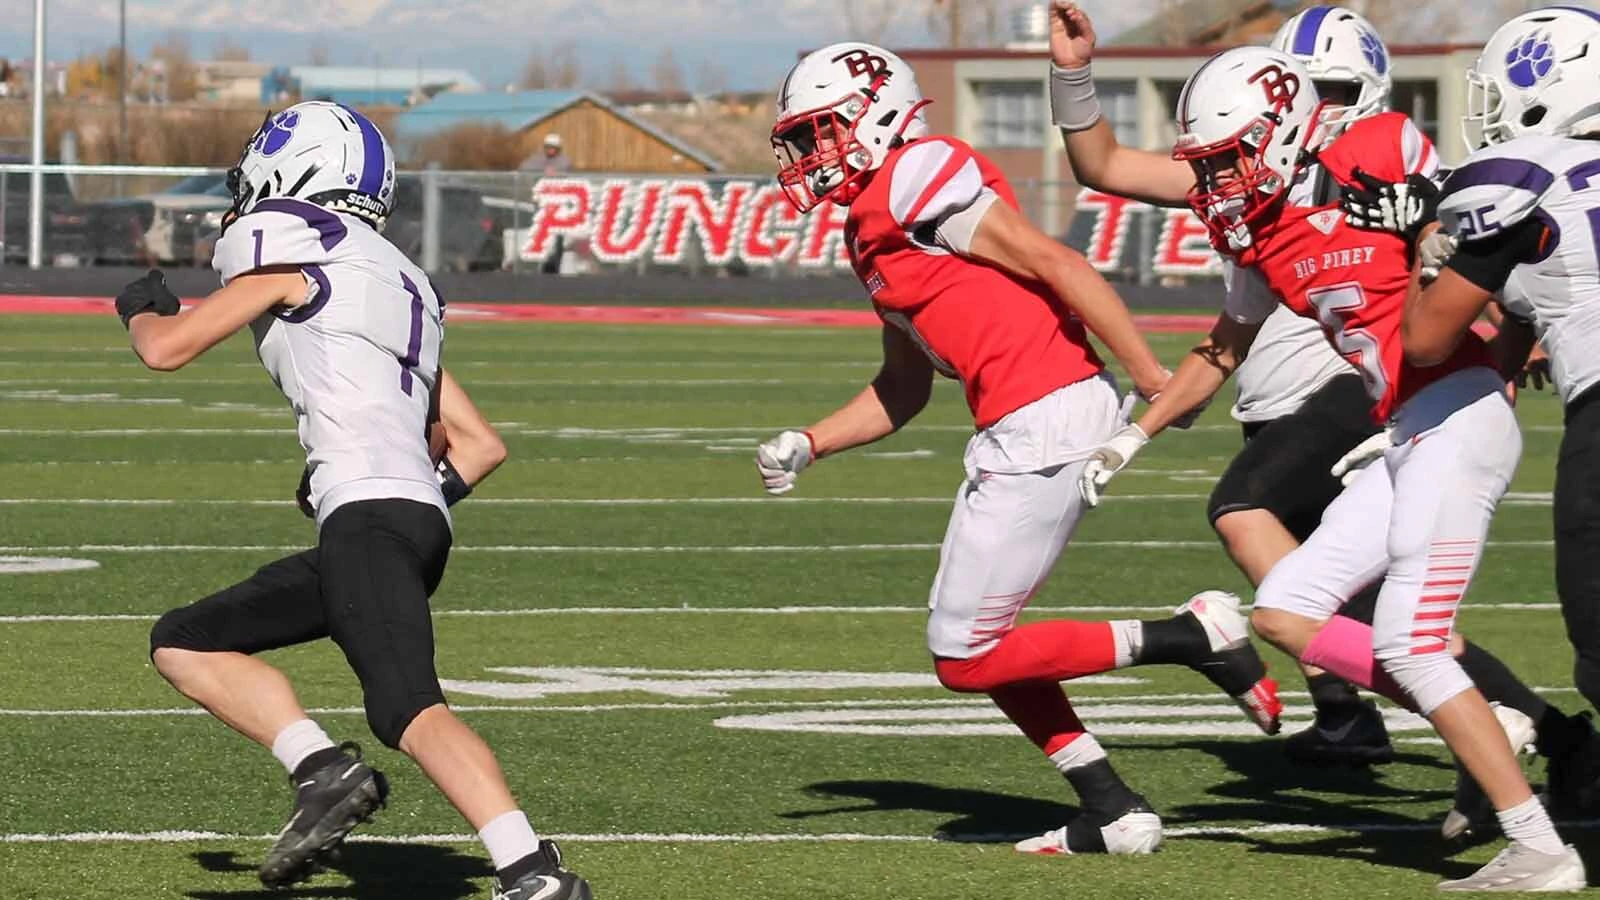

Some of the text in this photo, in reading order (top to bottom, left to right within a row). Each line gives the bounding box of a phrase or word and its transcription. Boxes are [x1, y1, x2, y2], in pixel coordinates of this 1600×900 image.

[252, 229, 264, 269] 1
[1294, 246, 1376, 278] BIG PINEY
[400, 271, 425, 397] 1
[1305, 281, 1390, 401] 5
